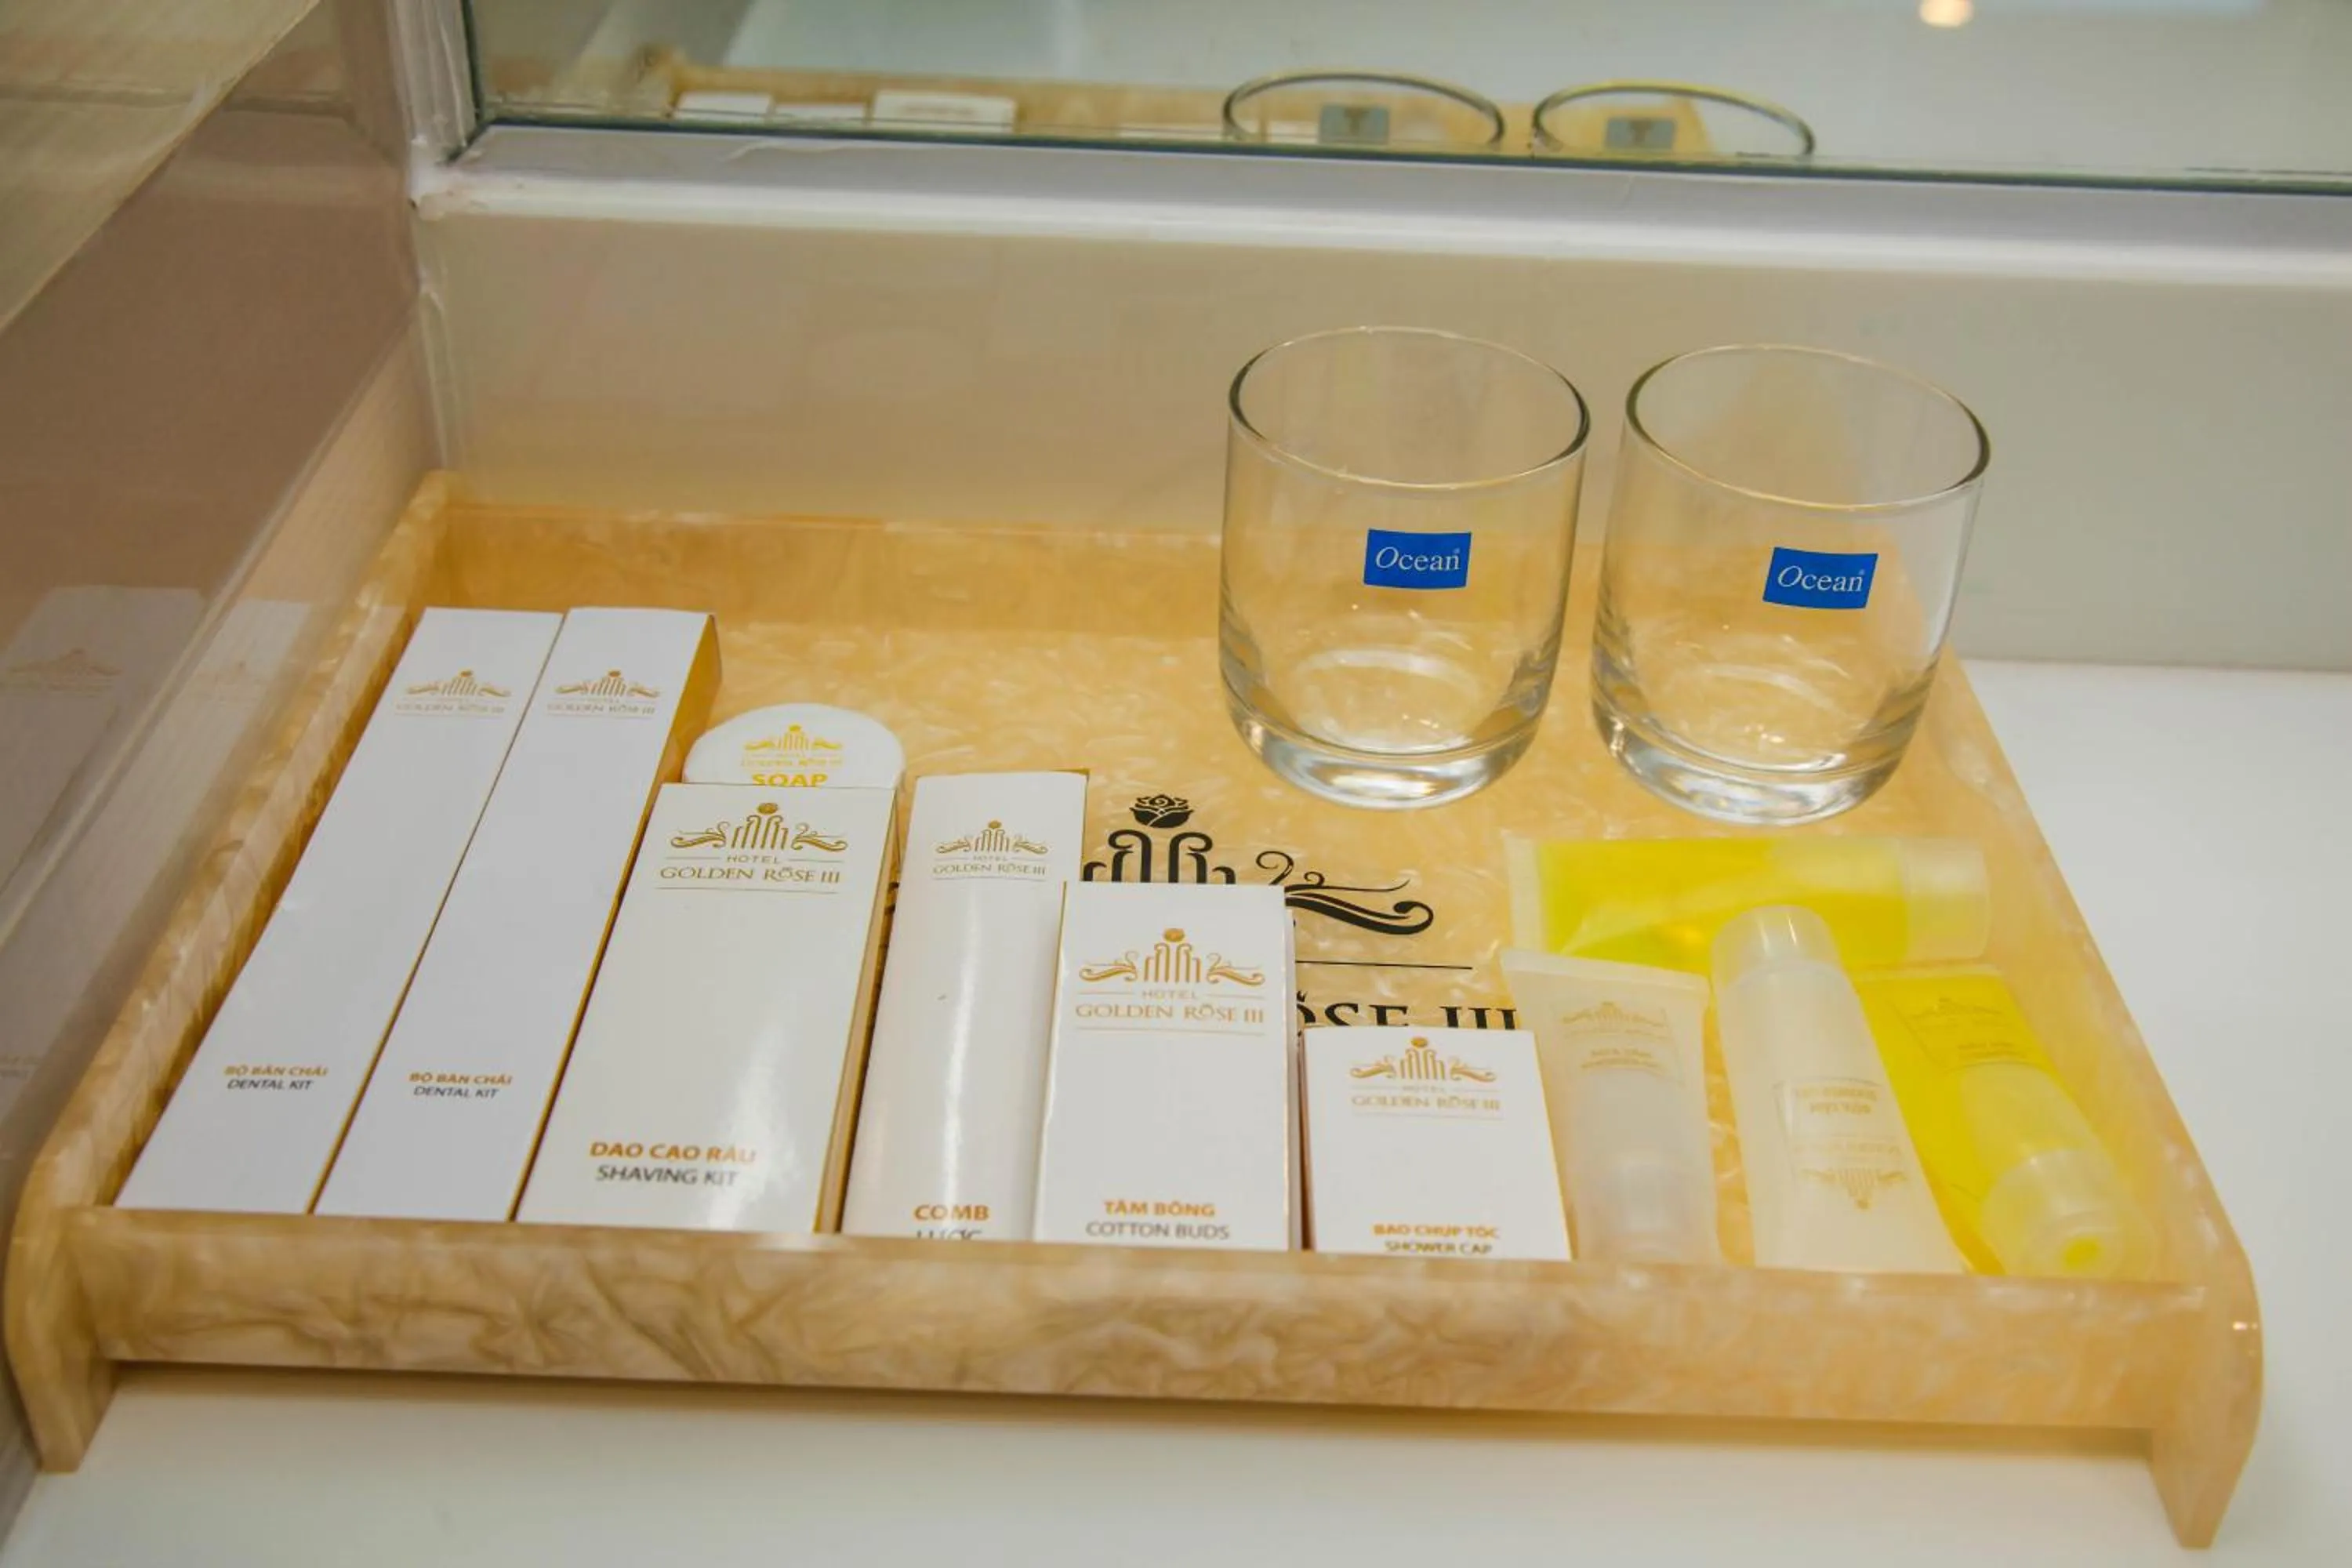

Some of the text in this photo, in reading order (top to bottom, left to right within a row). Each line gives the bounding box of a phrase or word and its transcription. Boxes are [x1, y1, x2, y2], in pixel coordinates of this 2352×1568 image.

[1376, 546, 1461, 572] Ocean
[1777, 564, 1864, 593] Ocean
[751, 773, 829, 788] SOAP
[726, 854, 784, 865] HOTEL
[659, 866, 754, 880] GOLDEN
[932, 863, 992, 874] GOLDEN
[1141, 989, 1197, 1000] HOTEL
[1075, 1003, 1174, 1018] GOLDEN
[227, 1078, 314, 1091] DENTAL KIT
[413, 1086, 500, 1099] DENTAL KIT
[590, 1142, 644, 1159] DAO
[596, 1165, 740, 1187] SHAVING KIT
[914, 1203, 990, 1221] COMB
[1085, 1221, 1231, 1240] COTTON BUDS
[1384, 1240, 1493, 1255] SHOWER CAP
